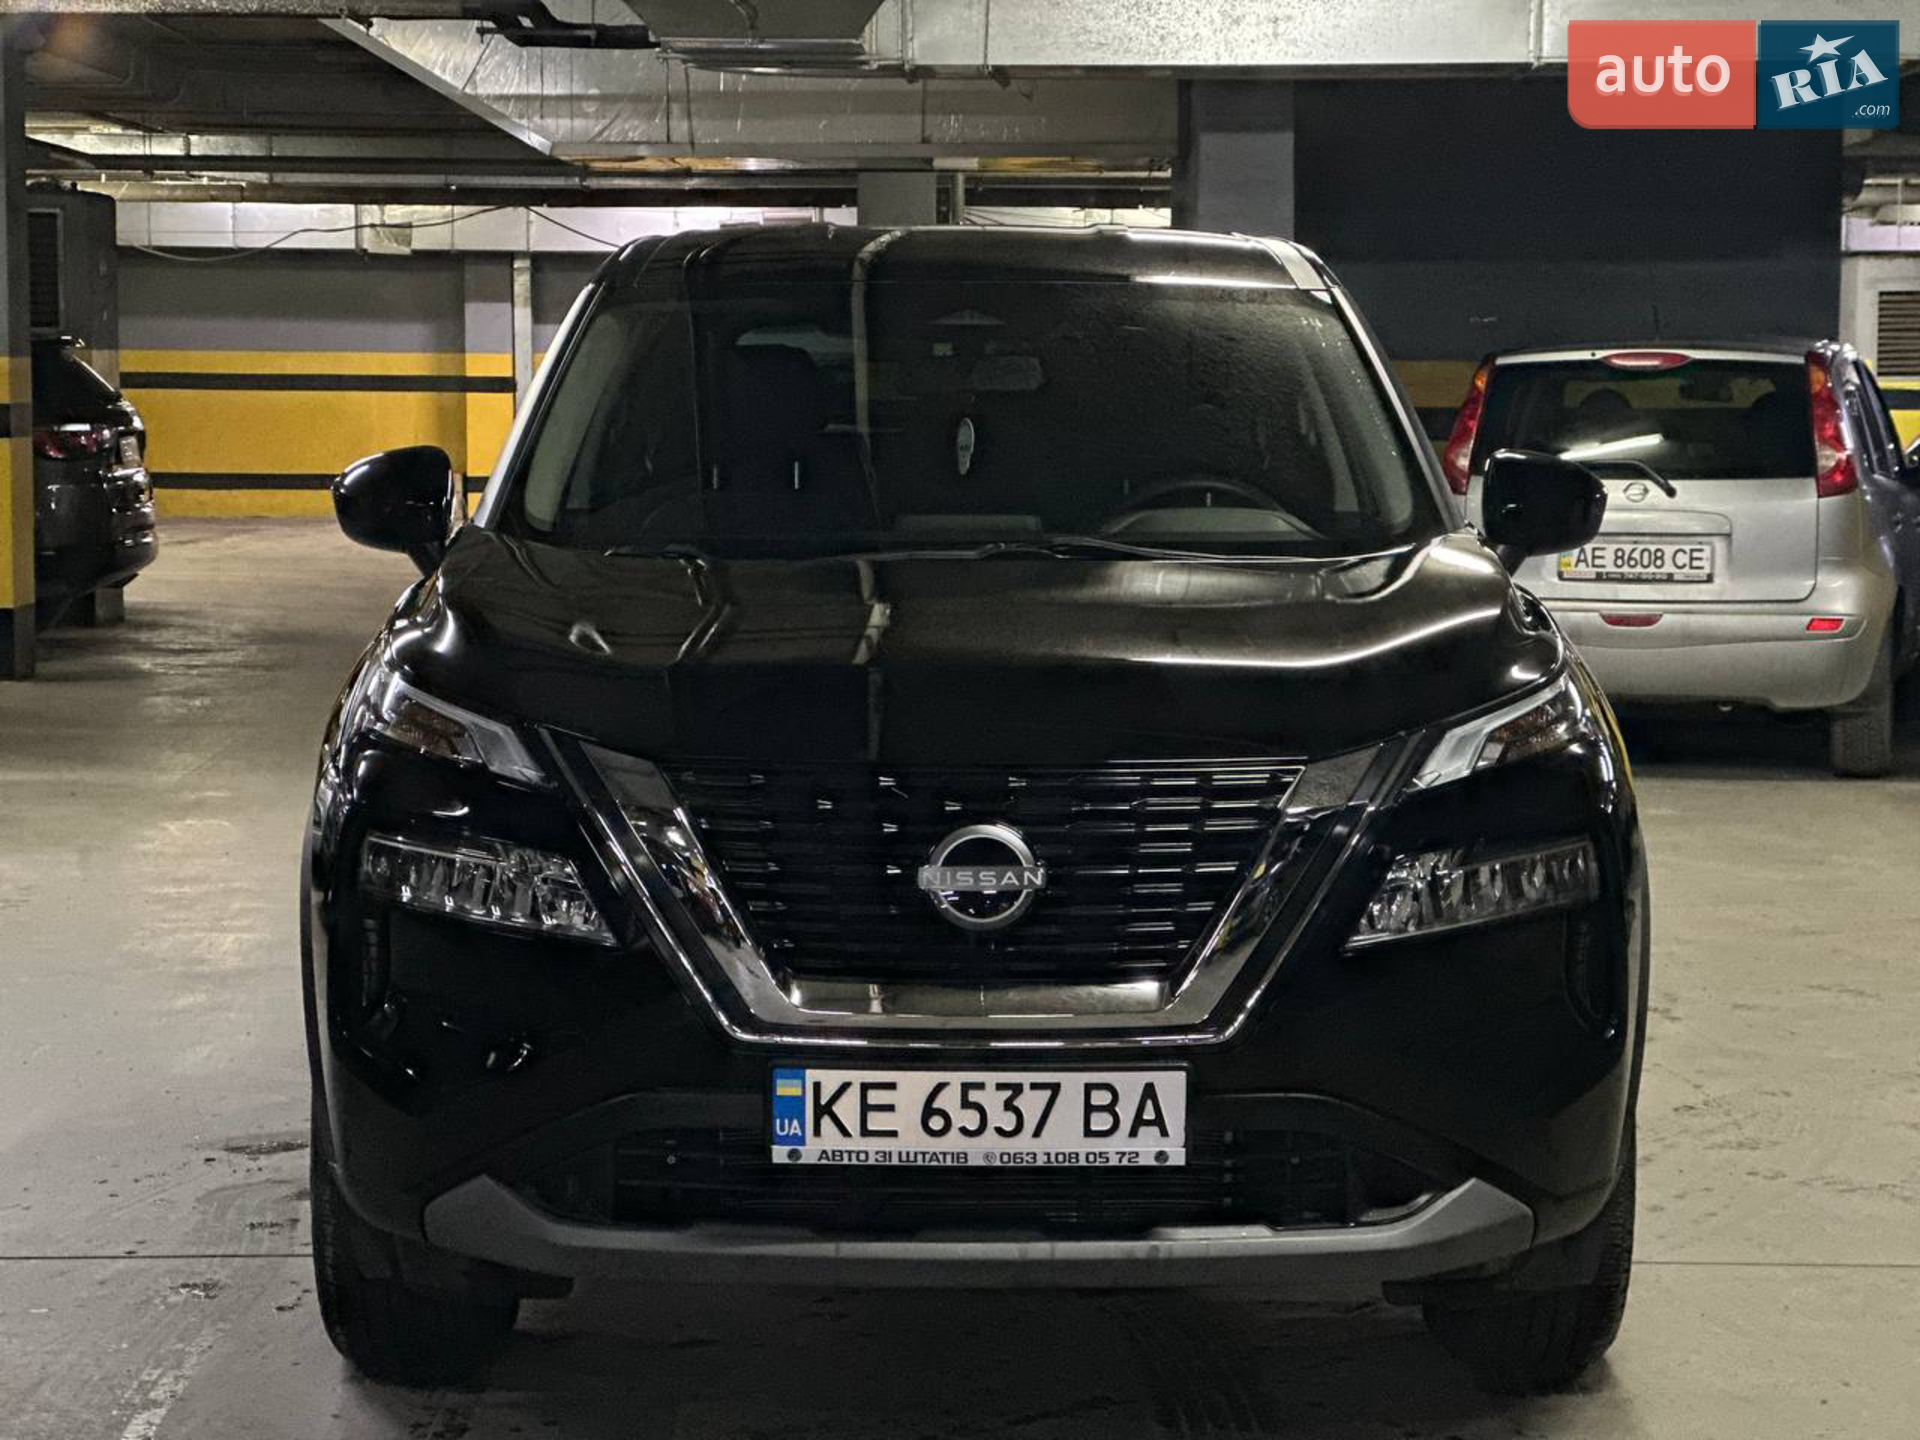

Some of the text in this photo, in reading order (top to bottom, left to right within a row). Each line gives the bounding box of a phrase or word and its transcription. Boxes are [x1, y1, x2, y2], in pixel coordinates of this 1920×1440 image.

[1574, 547, 1607, 568] AE
[1613, 548, 1665, 569] 8608
[1672, 548, 1705, 570] CE
[923, 870, 1042, 886] NISSAN
[812, 1081, 1170, 1138] KE 6537 BA
[775, 1118, 803, 1136] UA
[817, 1150, 1140, 1164] АВТО ЗІ ШТАТІВ 063 108 05 72
